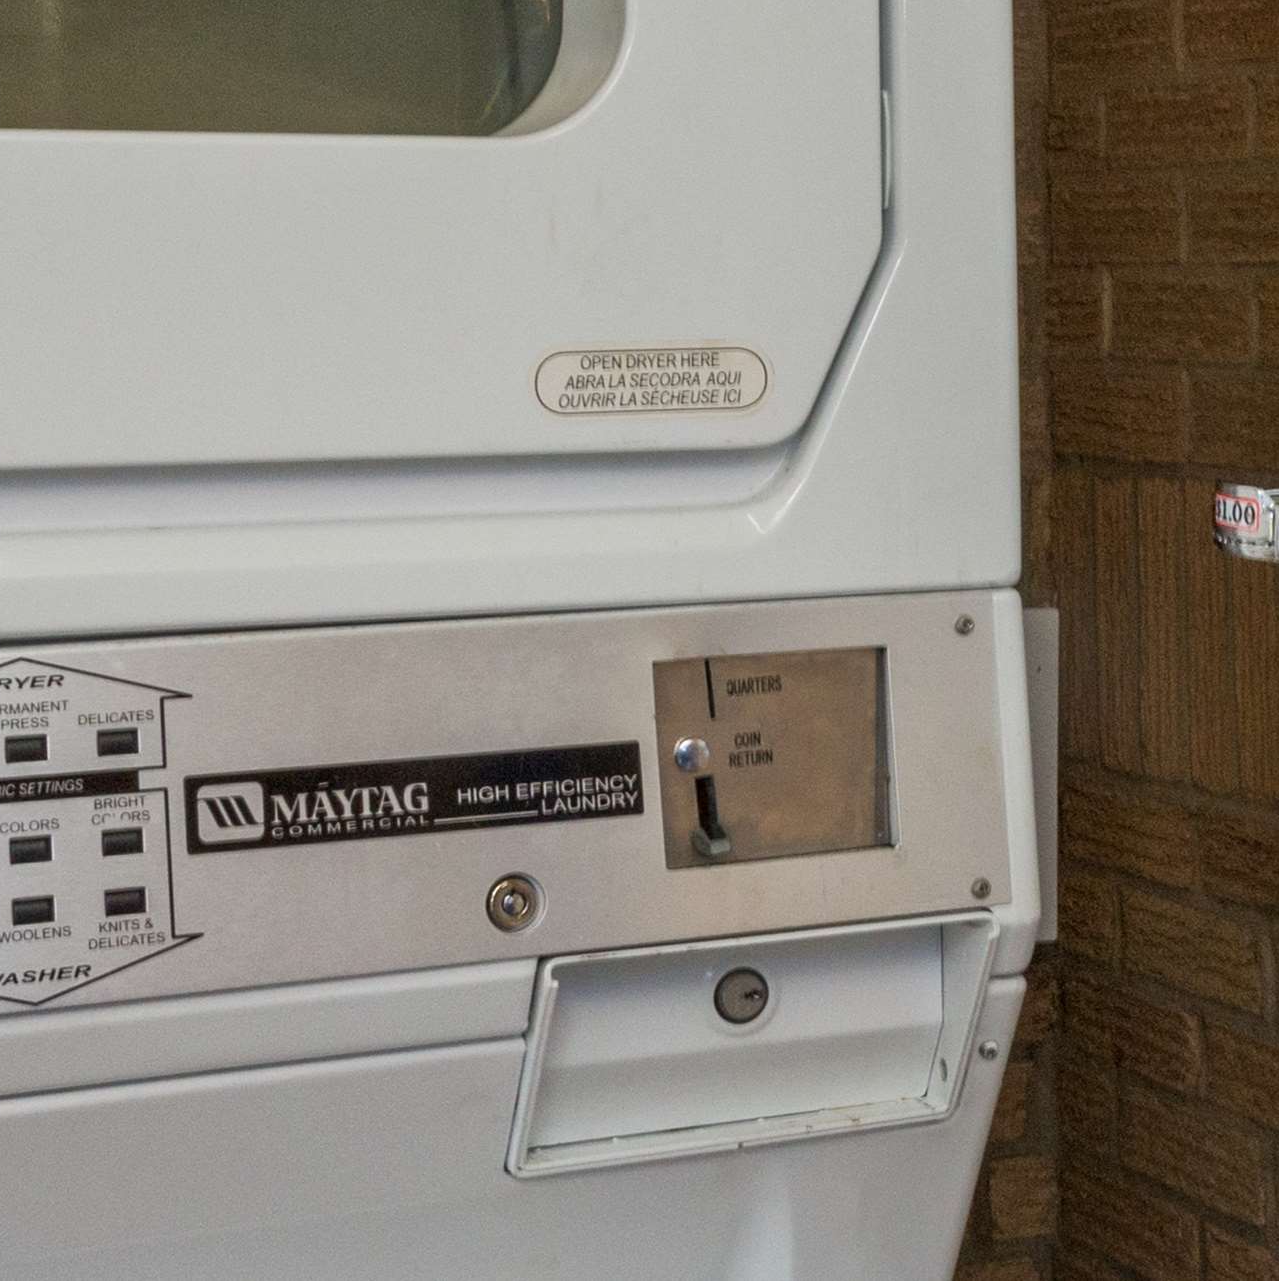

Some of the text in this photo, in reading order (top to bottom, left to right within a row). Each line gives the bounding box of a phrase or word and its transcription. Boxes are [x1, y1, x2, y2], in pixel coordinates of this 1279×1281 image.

[579, 351, 720, 371] OPEN DRYER HERE
[565, 370, 742, 392] ABRA LA SECODRA AQUI
[558, 392, 617, 410] OUVRIR
[619, 392, 638, 408] LA
[722, 388, 742, 404] ICI
[726, 675, 782, 696] QUARTERS
[0, 716, 50, 731] PRESS
[77, 709, 155, 726] DELICATES
[734, 731, 762, 750] COIN
[728, 749, 774, 769] RETURN
[19, 778, 85, 797] SETTINGS
[93, 795, 147, 811] BRIGHT
[270, 773, 639, 826] MAYTAG HIGH EFFICIENCY
[540, 791, 639, 816] LAUNDRY
[270, 814, 430, 840] COMMERCIAL
[98, 917, 155, 934] KNITS &
[87, 931, 167, 951] DELICATES
